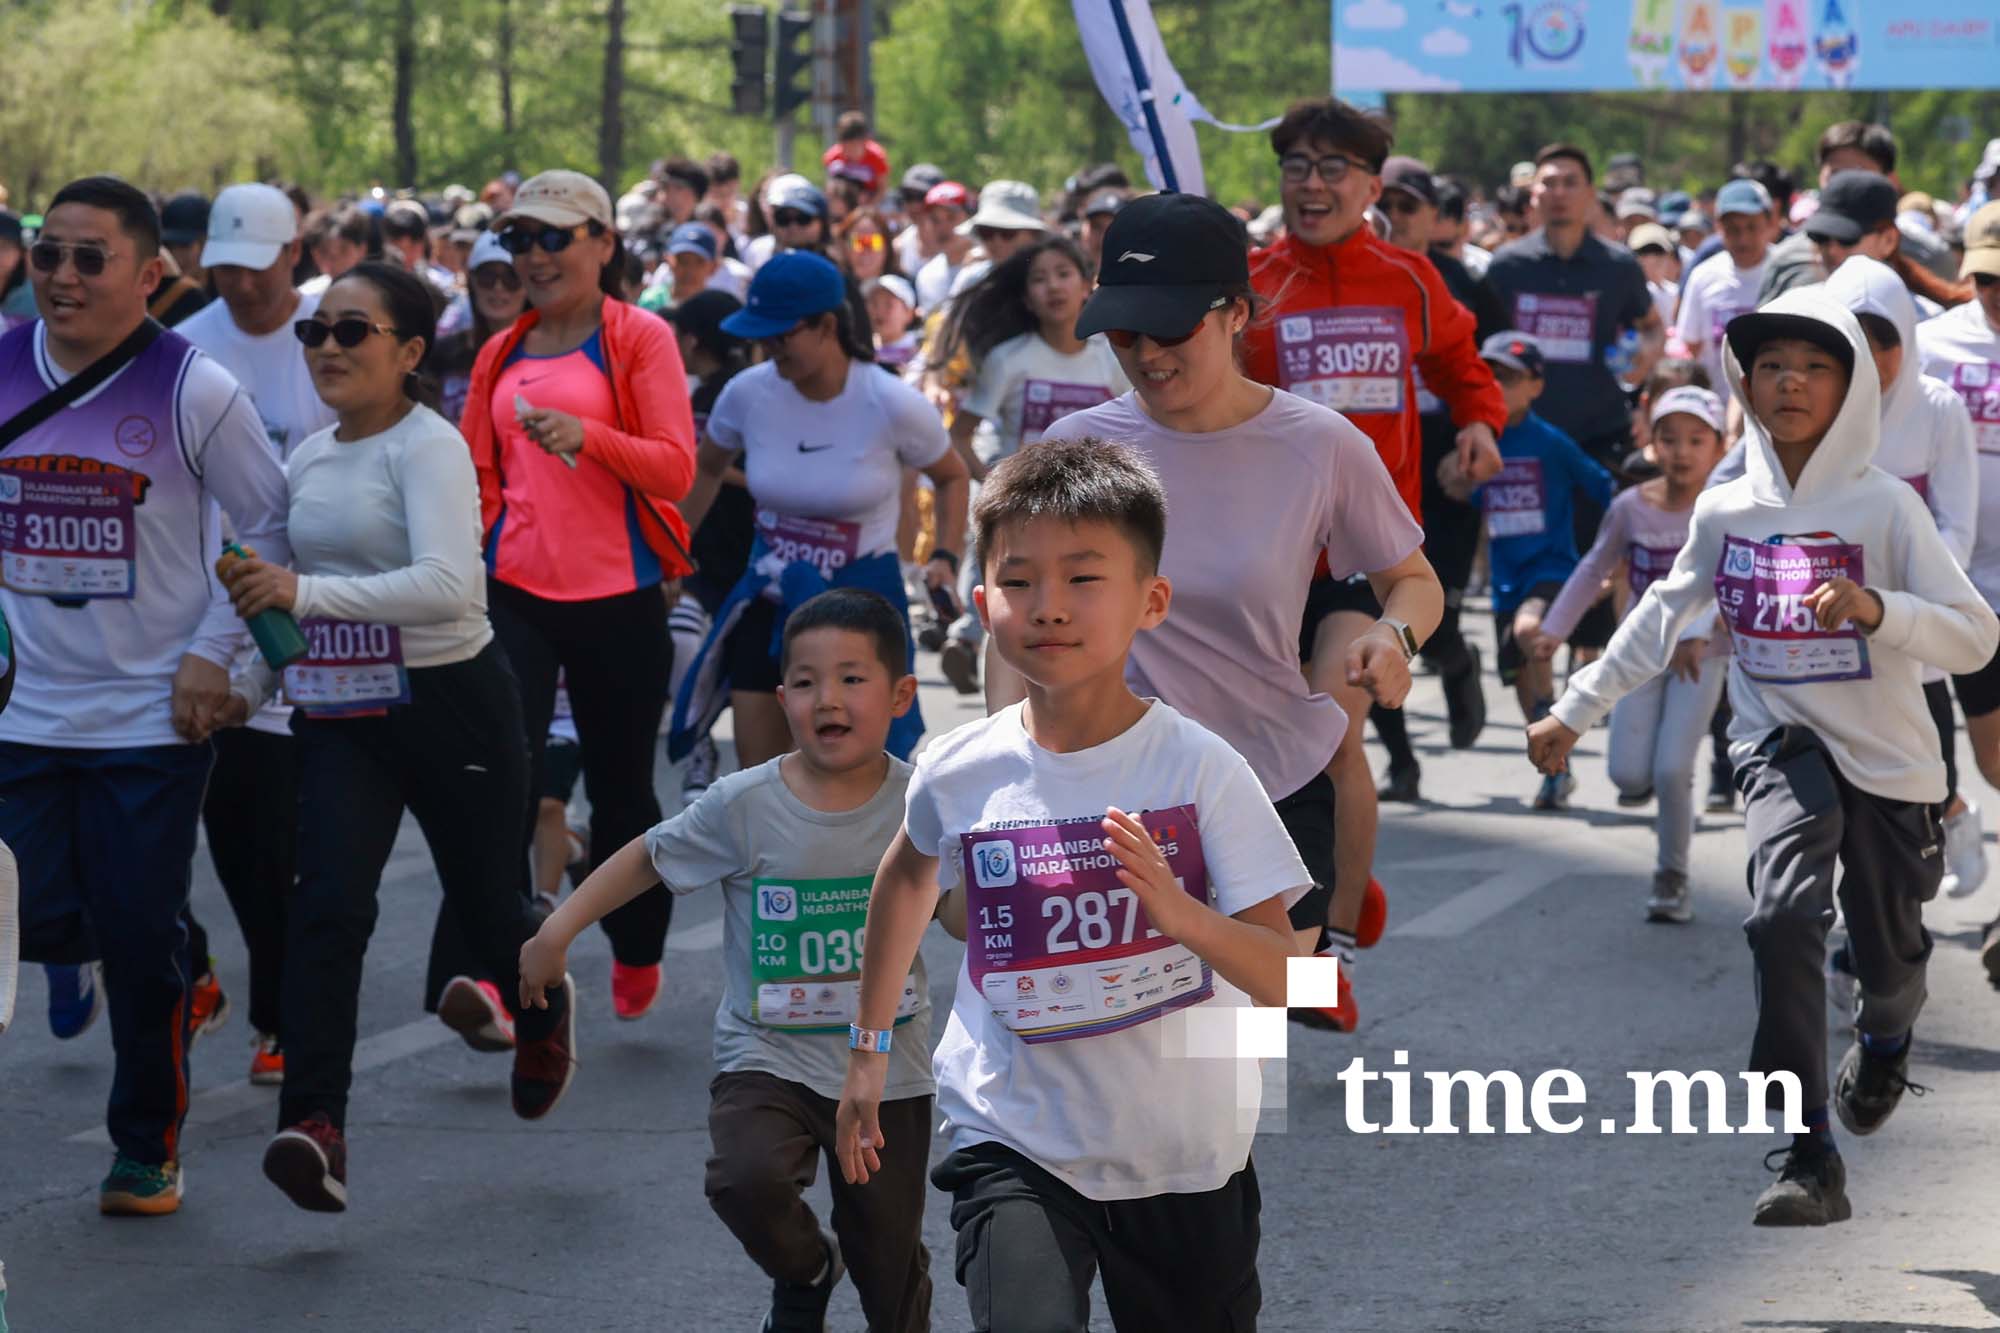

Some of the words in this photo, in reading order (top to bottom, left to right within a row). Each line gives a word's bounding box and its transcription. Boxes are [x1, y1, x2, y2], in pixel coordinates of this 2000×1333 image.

[1316, 341, 1400, 375] 30973
[24, 513, 124, 552] 31009
[1753, 591, 1854, 632] 275
[1019, 841, 1108, 859] ULAANBA
[761, 890, 792, 915] 10
[801, 888, 871, 902] ULAANBA
[979, 905, 1014, 930] 1.5
[1041, 887, 1165, 954] 287
[757, 933, 787, 951] 10
[984, 934, 1012, 949] KM
[758, 955, 787, 966] KM
